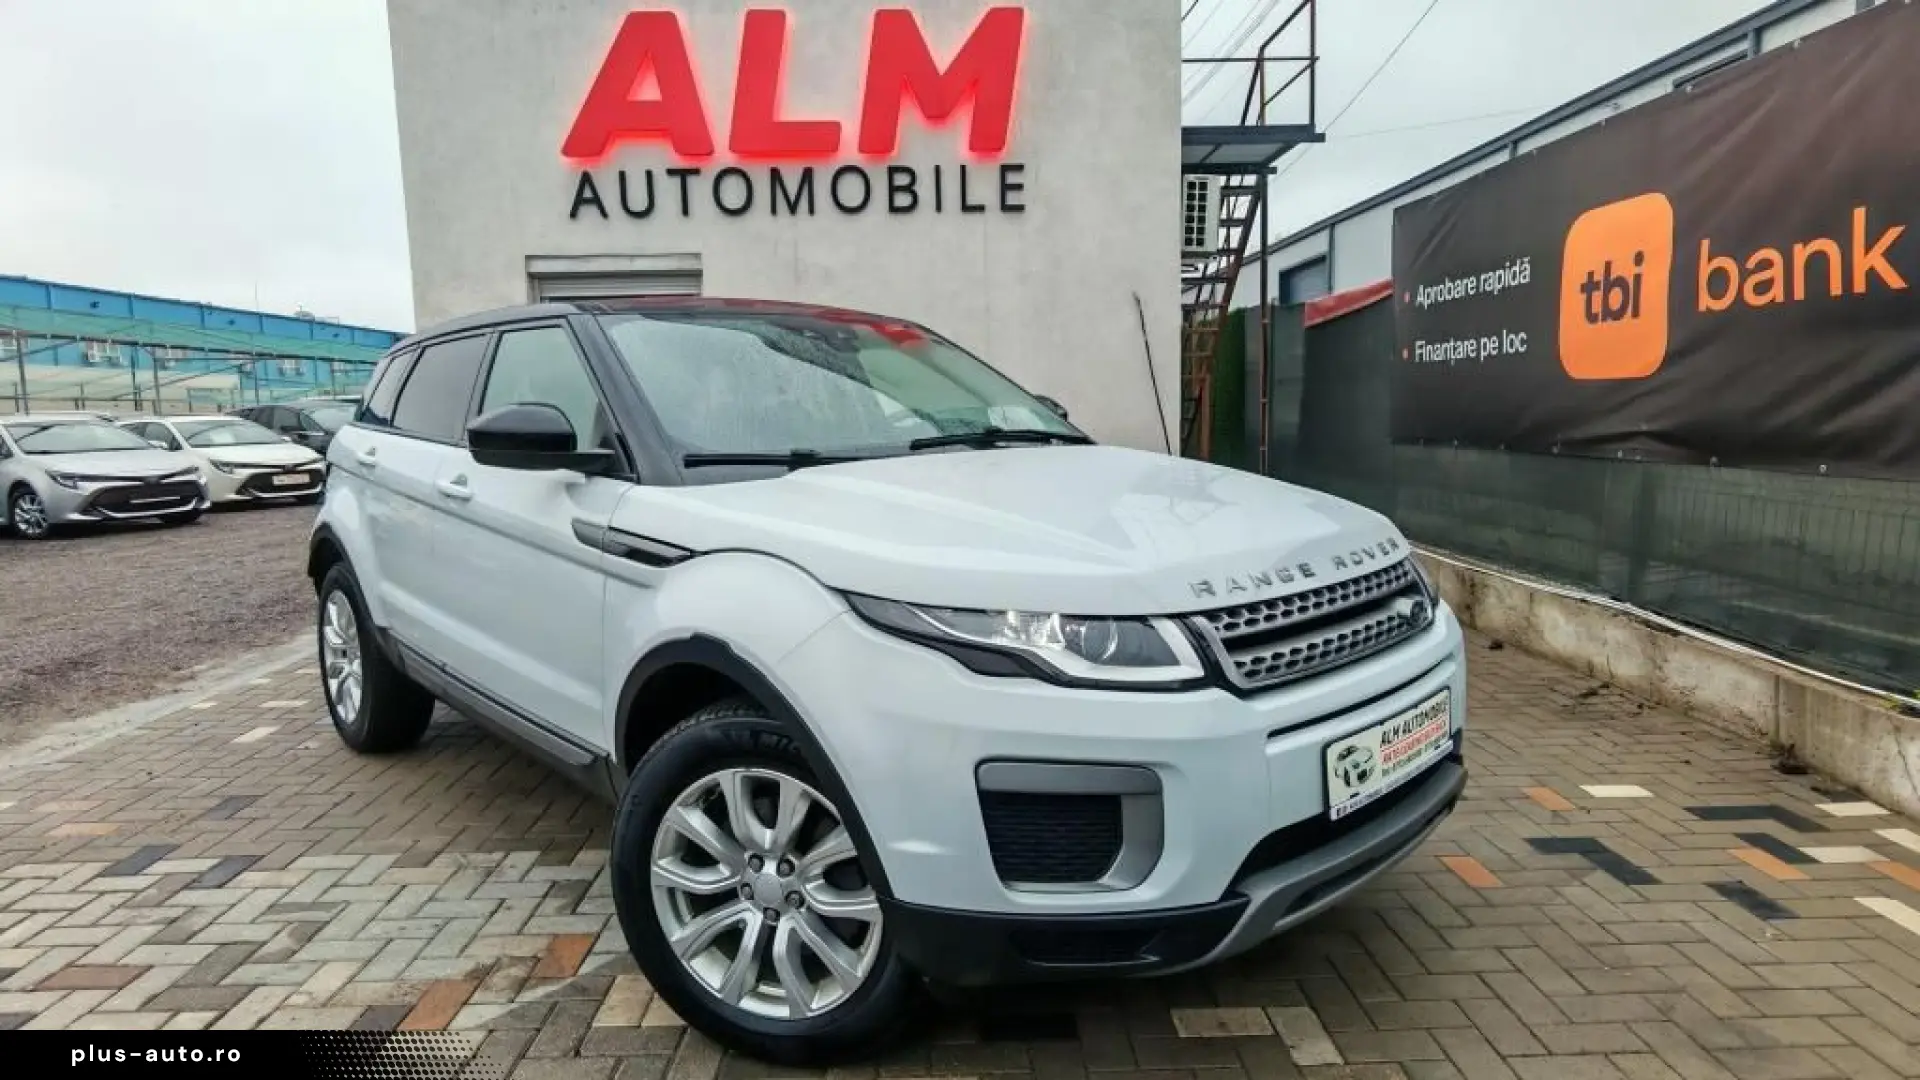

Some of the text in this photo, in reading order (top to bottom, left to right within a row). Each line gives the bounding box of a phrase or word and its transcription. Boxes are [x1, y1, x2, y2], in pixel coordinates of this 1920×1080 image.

[561, 6, 1025, 157] ALM
[569, 163, 1026, 219] AUTOMOBILE
[1415, 255, 1531, 309] Aprobare rapidă
[1580, 205, 1909, 325] tbi bank
[1414, 329, 1528, 366] Finanțare pe loc
[1188, 536, 1400, 599] RANGE ROVER
